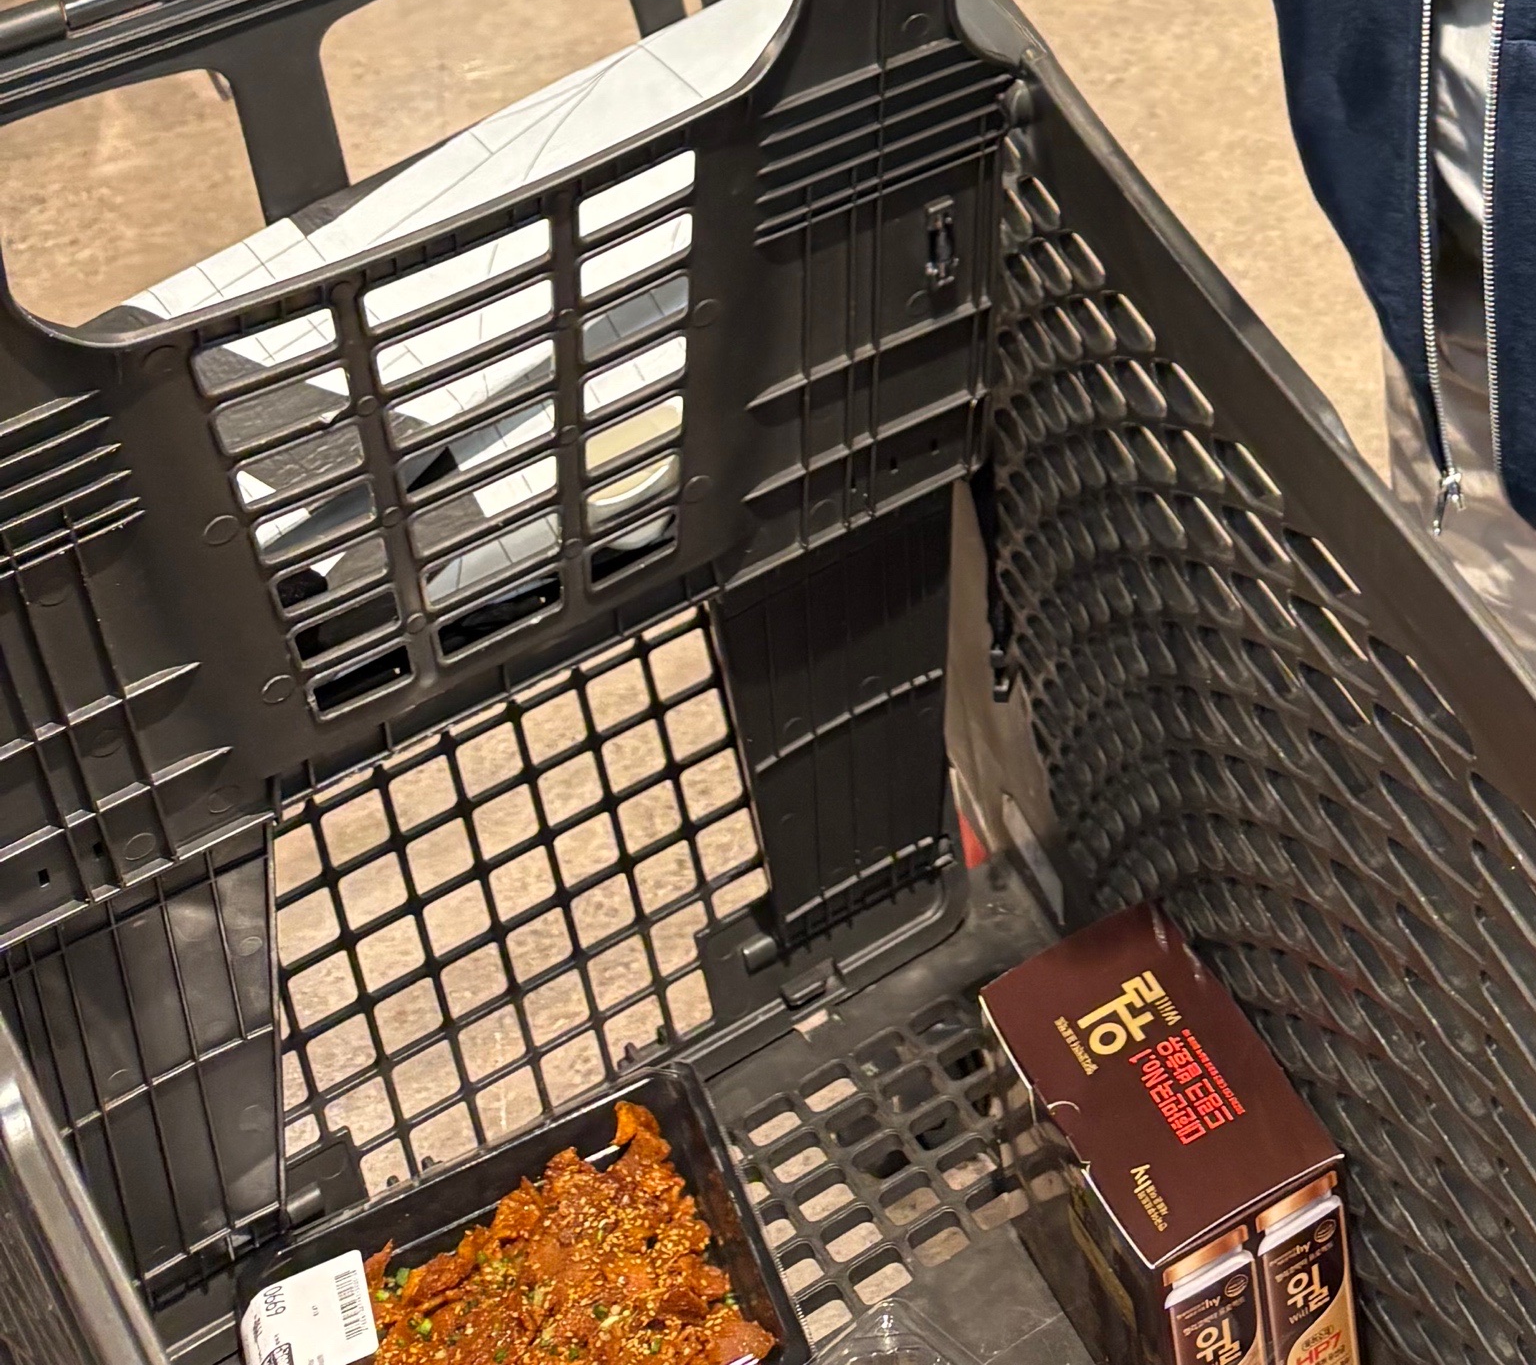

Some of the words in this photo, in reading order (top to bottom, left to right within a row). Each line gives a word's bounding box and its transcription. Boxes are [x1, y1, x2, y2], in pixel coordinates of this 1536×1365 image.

[1078, 971, 1165, 1055] 월
[1153, 996, 1183, 1026] Will
[1128, 1048, 1168, 1088] No.1
[1156, 1036, 1202, 1085] 발효유
[1148, 1077, 1207, 1146] 대한민국
[1186, 1077, 1234, 1131] 드링크
[1128, 1163, 1151, 1194] hy
[1286, 1263, 1332, 1313] 월
[1196, 1319, 1244, 1365] 월
[1295, 1336, 1342, 1365] HP7
